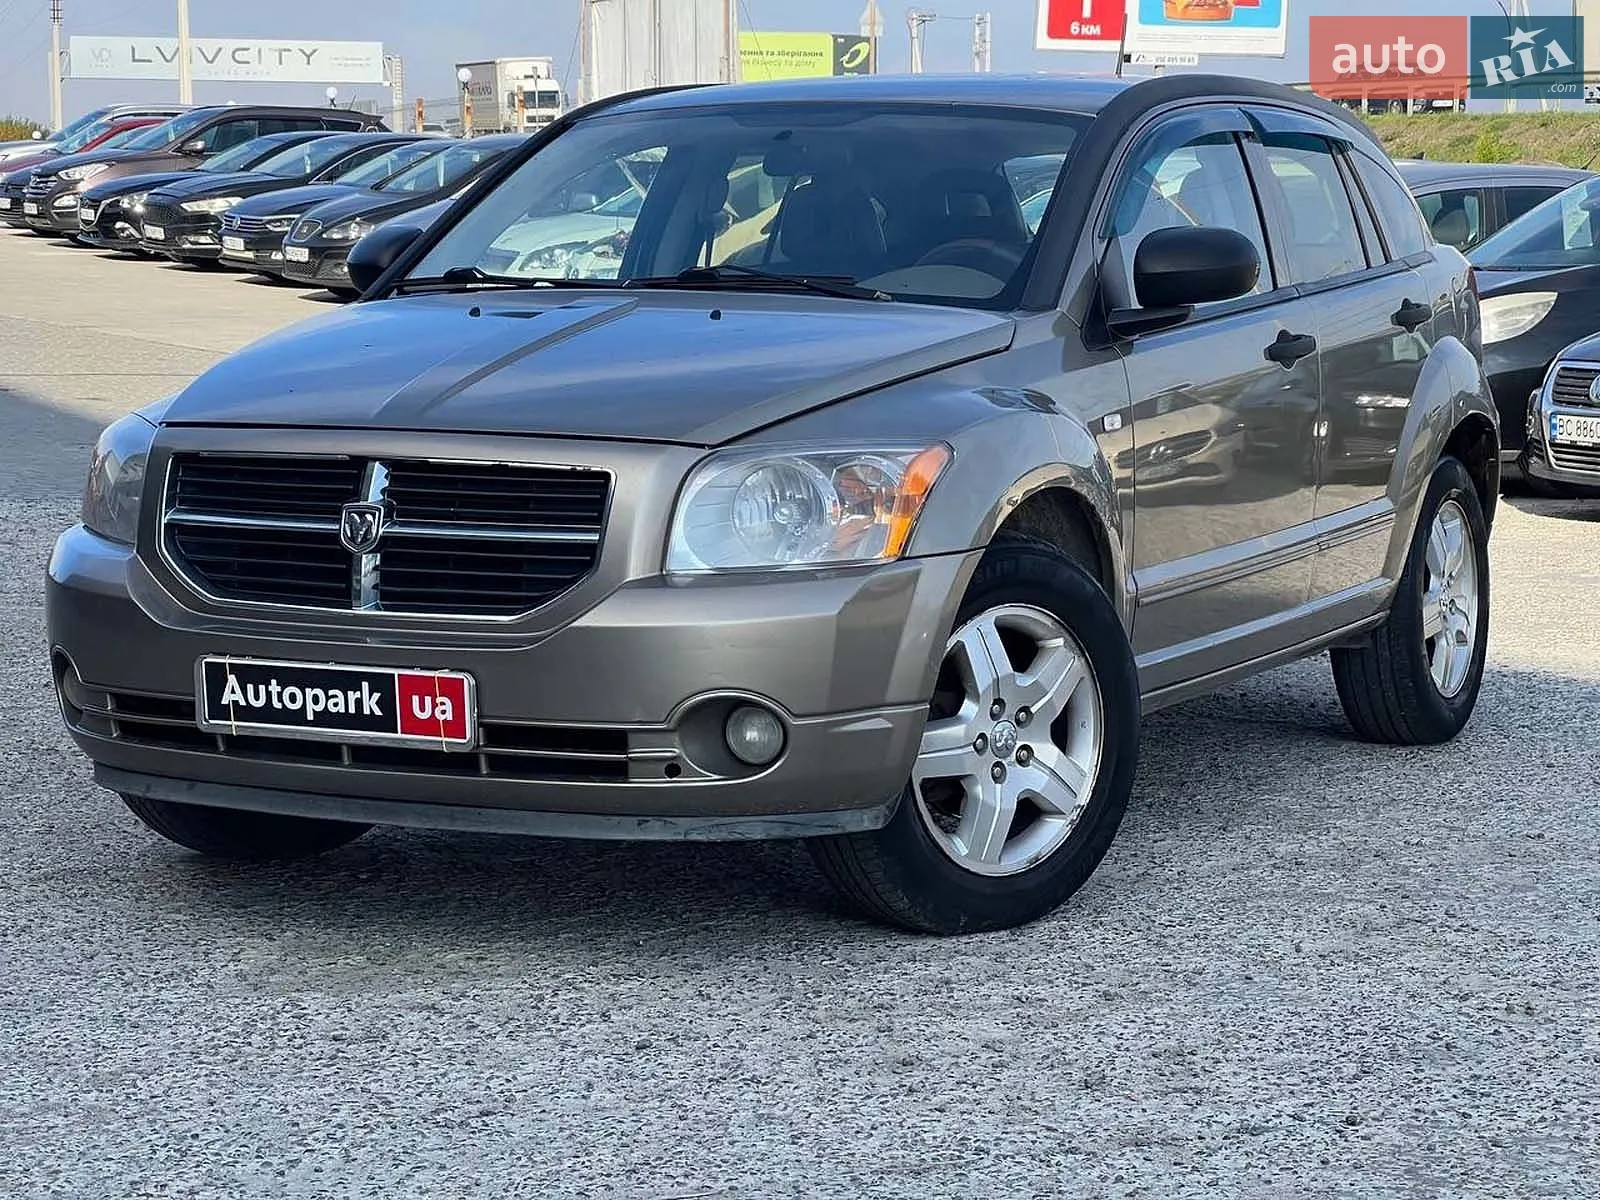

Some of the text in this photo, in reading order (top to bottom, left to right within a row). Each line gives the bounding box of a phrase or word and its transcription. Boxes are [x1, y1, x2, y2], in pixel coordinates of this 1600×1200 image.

[1070, 21, 1080, 35] 6
[1558, 418, 1573, 436] BC
[220, 673, 454, 721] Autopark ua
